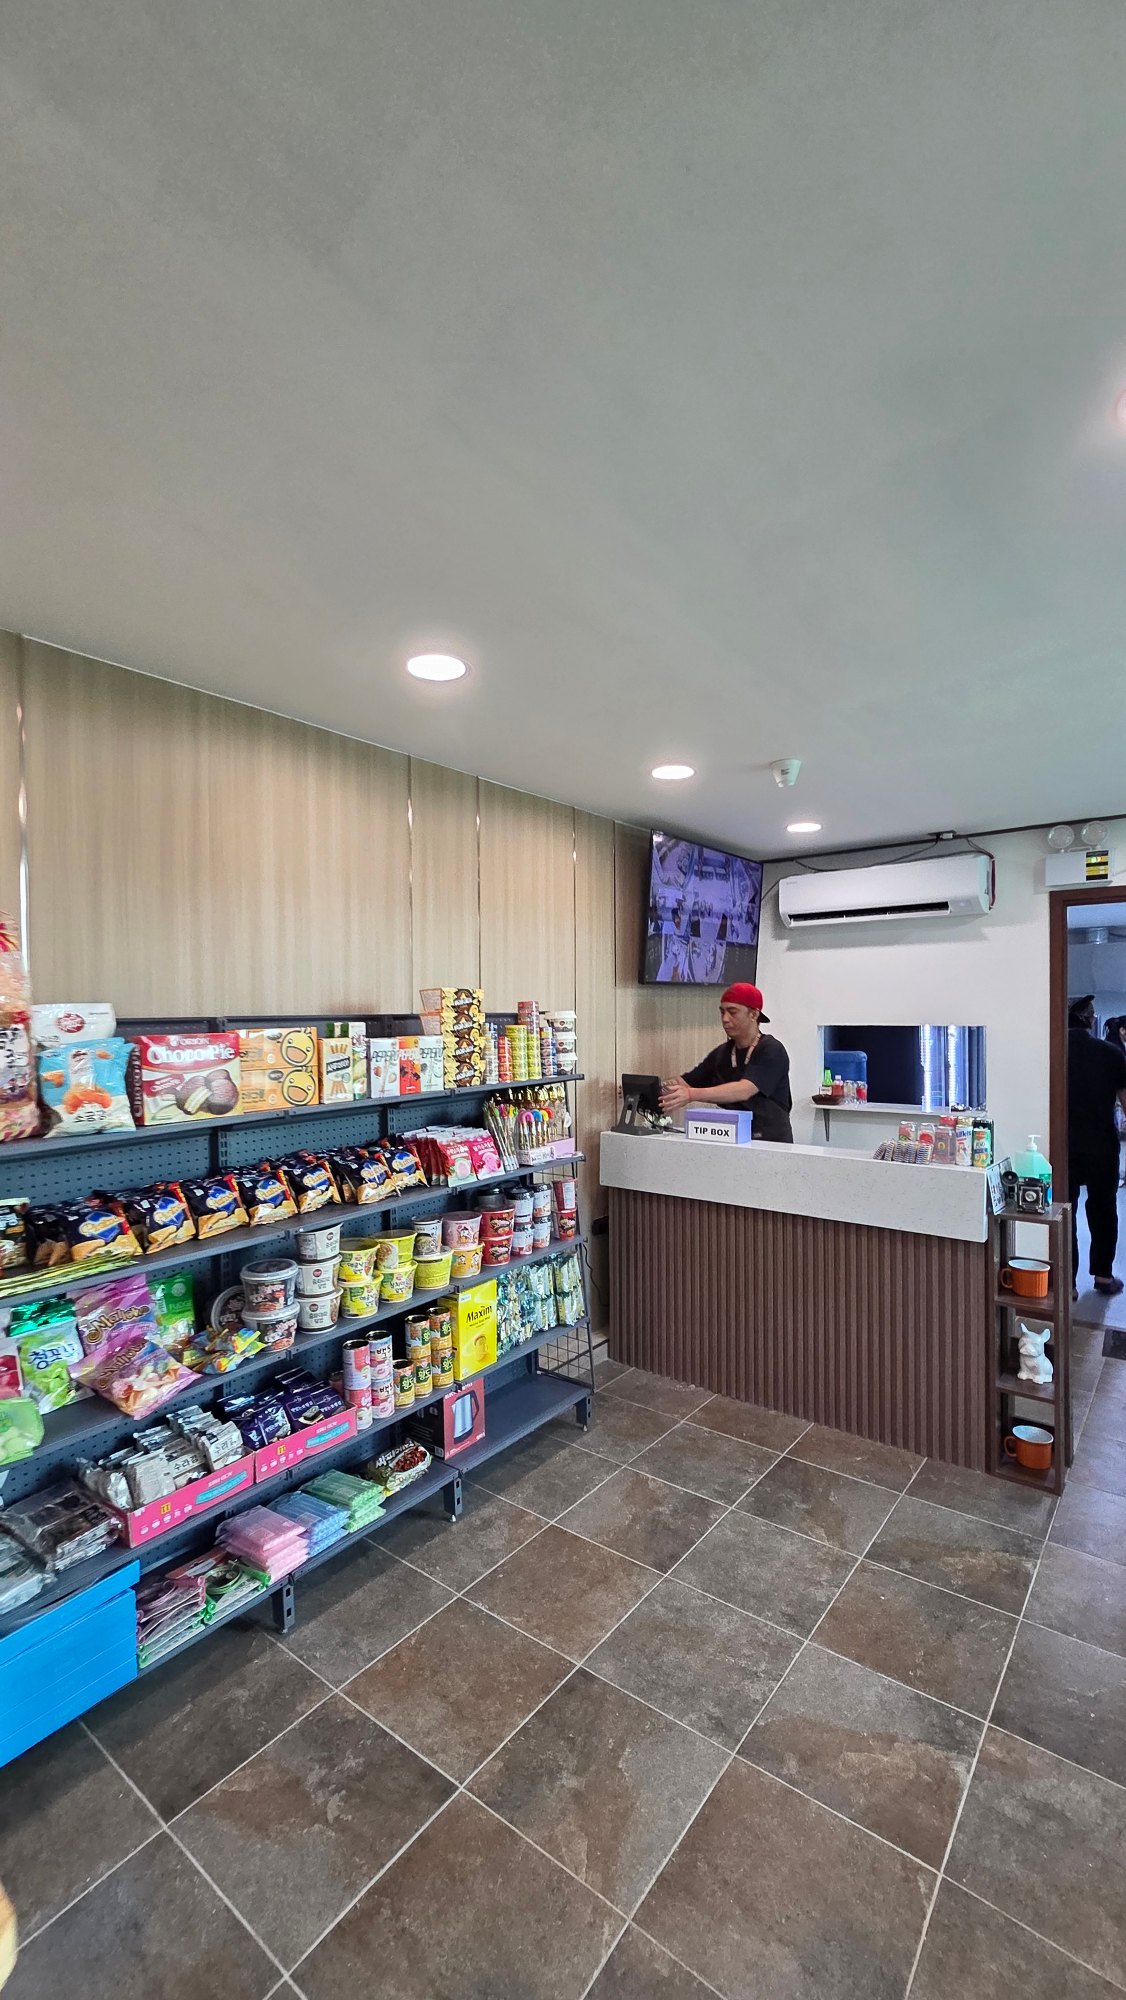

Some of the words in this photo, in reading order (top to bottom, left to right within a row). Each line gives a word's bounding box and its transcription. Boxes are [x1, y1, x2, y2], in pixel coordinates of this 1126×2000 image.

[693, 1126, 708, 1136] TIP
[710, 1128, 730, 1138] BOX
[465, 1305, 493, 1324] Maxim
